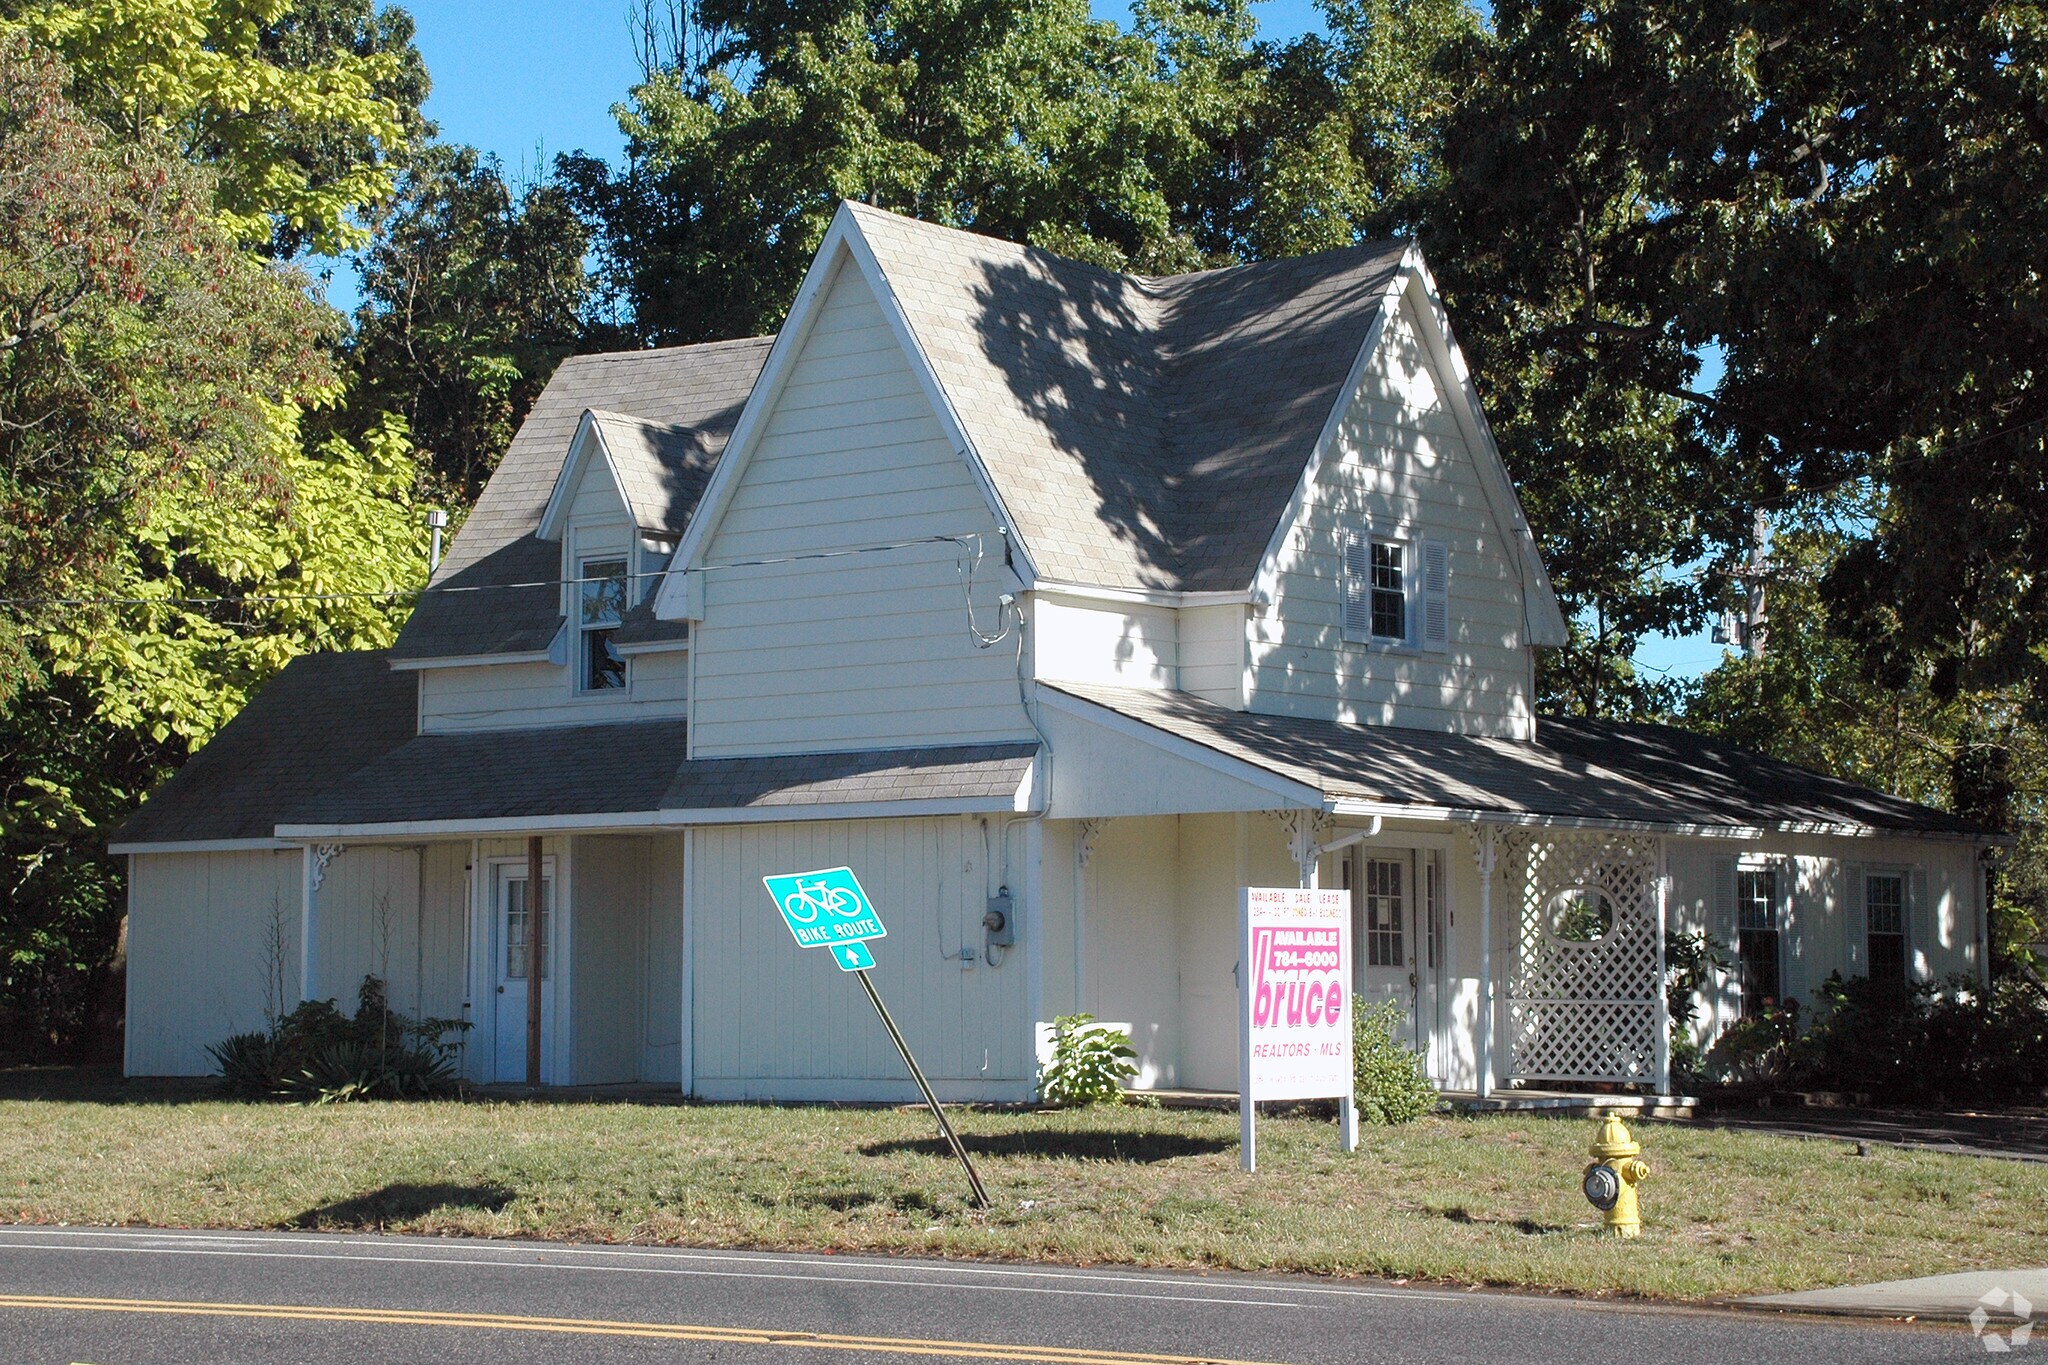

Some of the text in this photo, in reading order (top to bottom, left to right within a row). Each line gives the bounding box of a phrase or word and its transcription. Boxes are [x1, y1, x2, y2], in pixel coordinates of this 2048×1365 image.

[1251, 892, 1339, 904] AVAILABLE SALE LEASE
[796, 918, 879, 943] BIKE ROUTE
[1273, 930, 1338, 947] AVAILABLE
[1273, 950, 1338, 967] 784-6000
[1253, 933, 1342, 1029] bruce
[1253, 1042, 1342, 1058] REALTORS MLS
